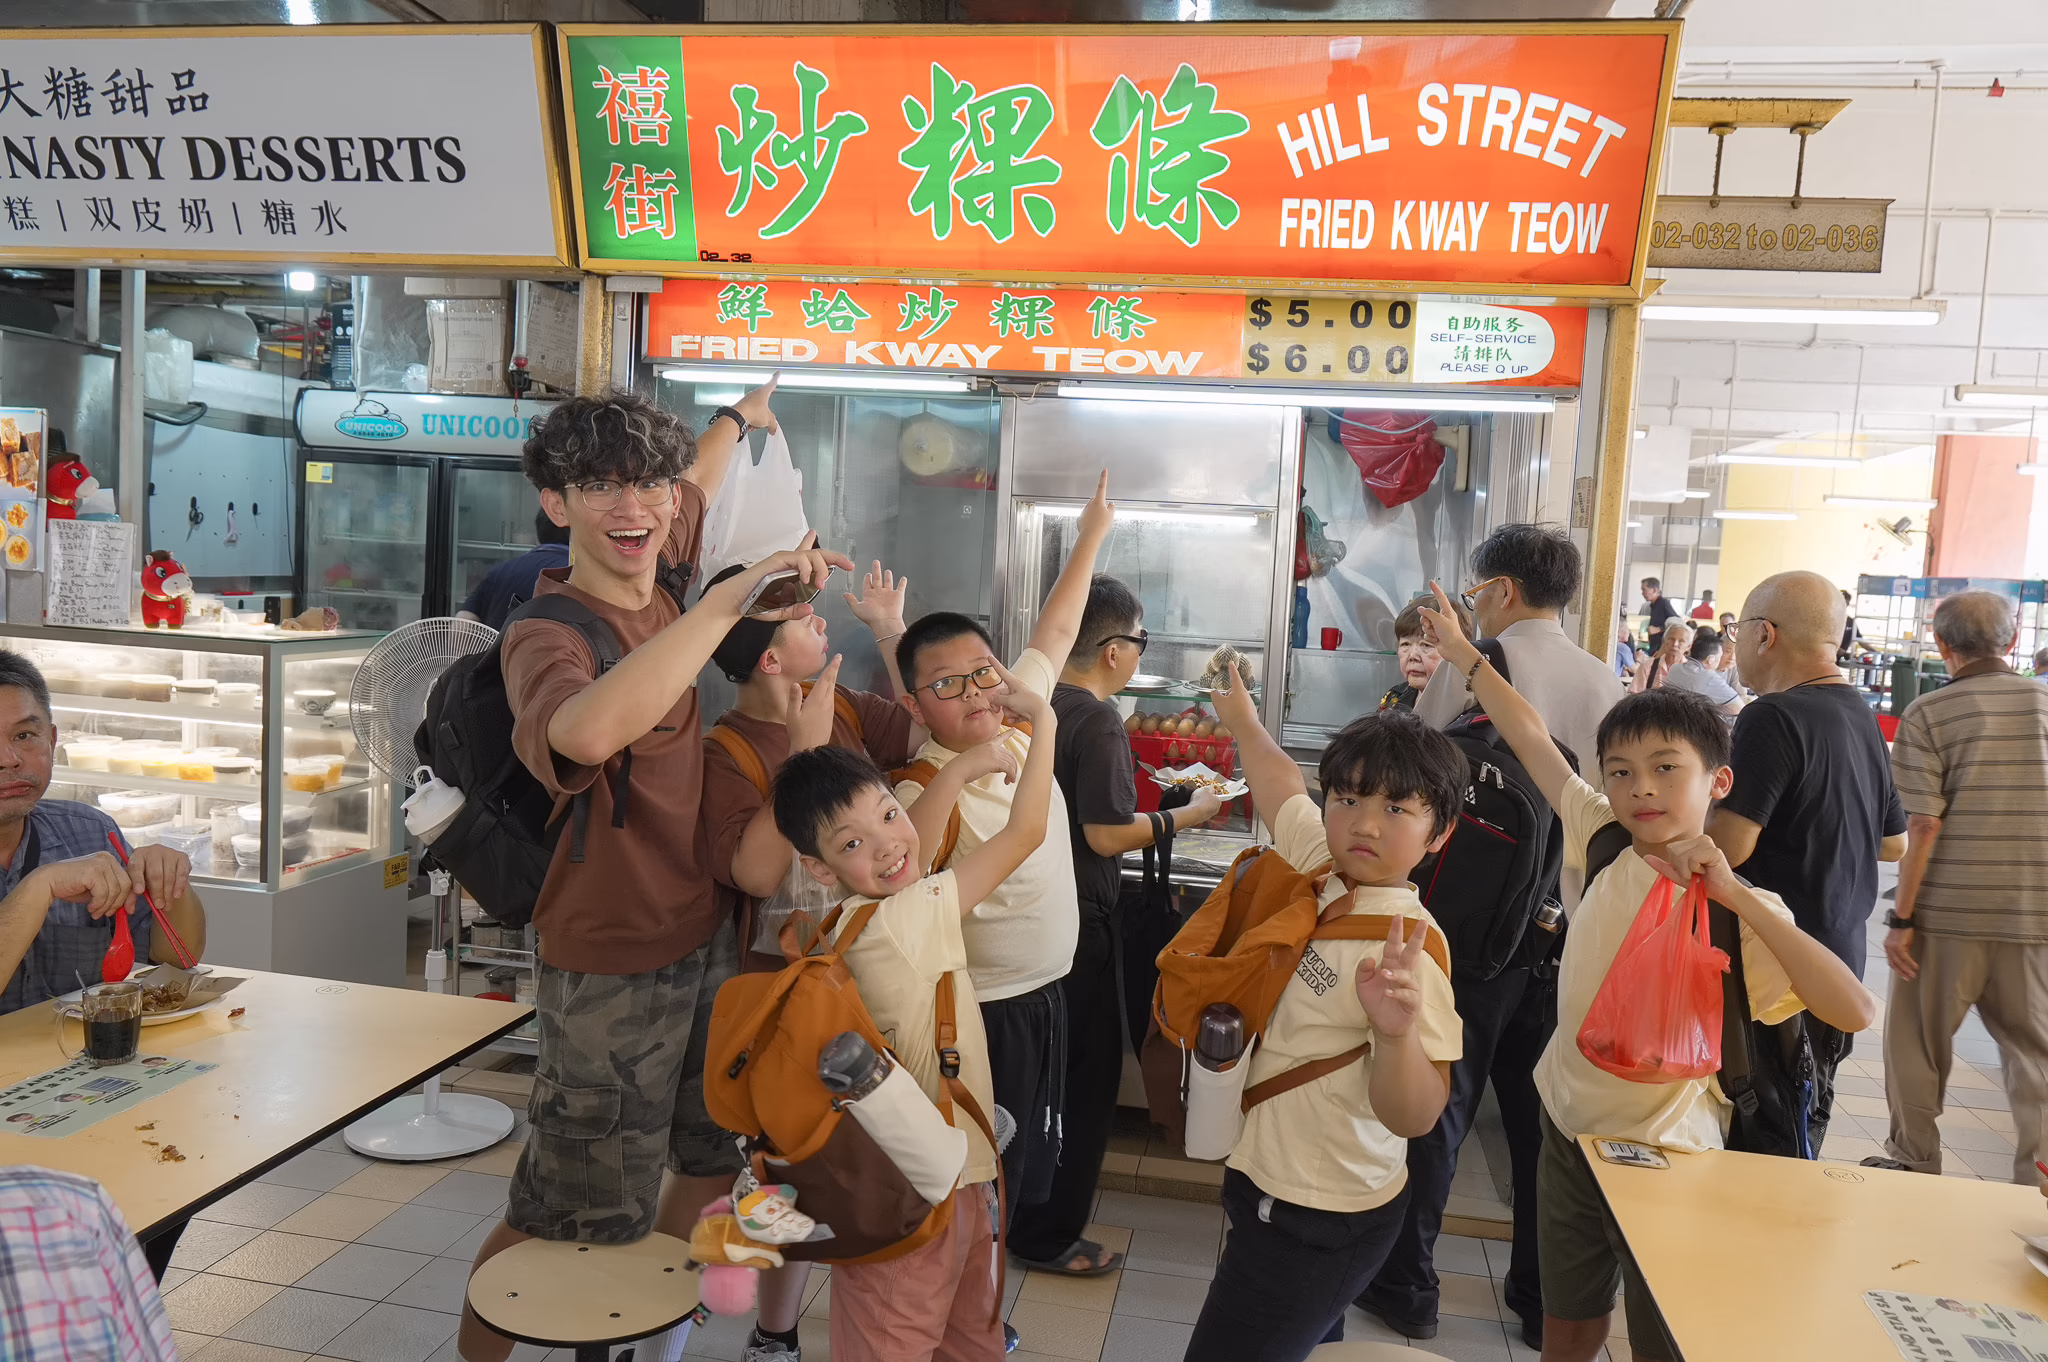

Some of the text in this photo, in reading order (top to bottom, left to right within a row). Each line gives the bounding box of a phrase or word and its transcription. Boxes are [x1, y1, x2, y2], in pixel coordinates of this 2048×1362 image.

[0, 66, 209, 120] 大糖甜品
[1277, 83, 1627, 179] HILL STREET
[3, 136, 466, 183] NASTY DESSERTS
[593, 65, 679, 240] 禧街
[716, 61, 1250, 248] 炒粿條
[3, 196, 348, 236] 糕 双皮奶 糖水
[1280, 198, 1609, 255] FRIED KWAY TEOW
[1650, 221, 1879, 252] 02-032 to 02-036
[1430, 333, 1537, 344] SELF-SERVICE
[1448, 316, 1524, 333] 自助服务
[671, 335, 1204, 375] FRIED KWAY TEOW
[1440, 363, 1529, 374] PLEASE Q UP
[344, 421, 402, 434] UNICOOL
[1296, 961, 1327, 996] KIDS
[1880, 1309, 1908, 1333] STAY
[1899, 1333, 1927, 1356] AND
